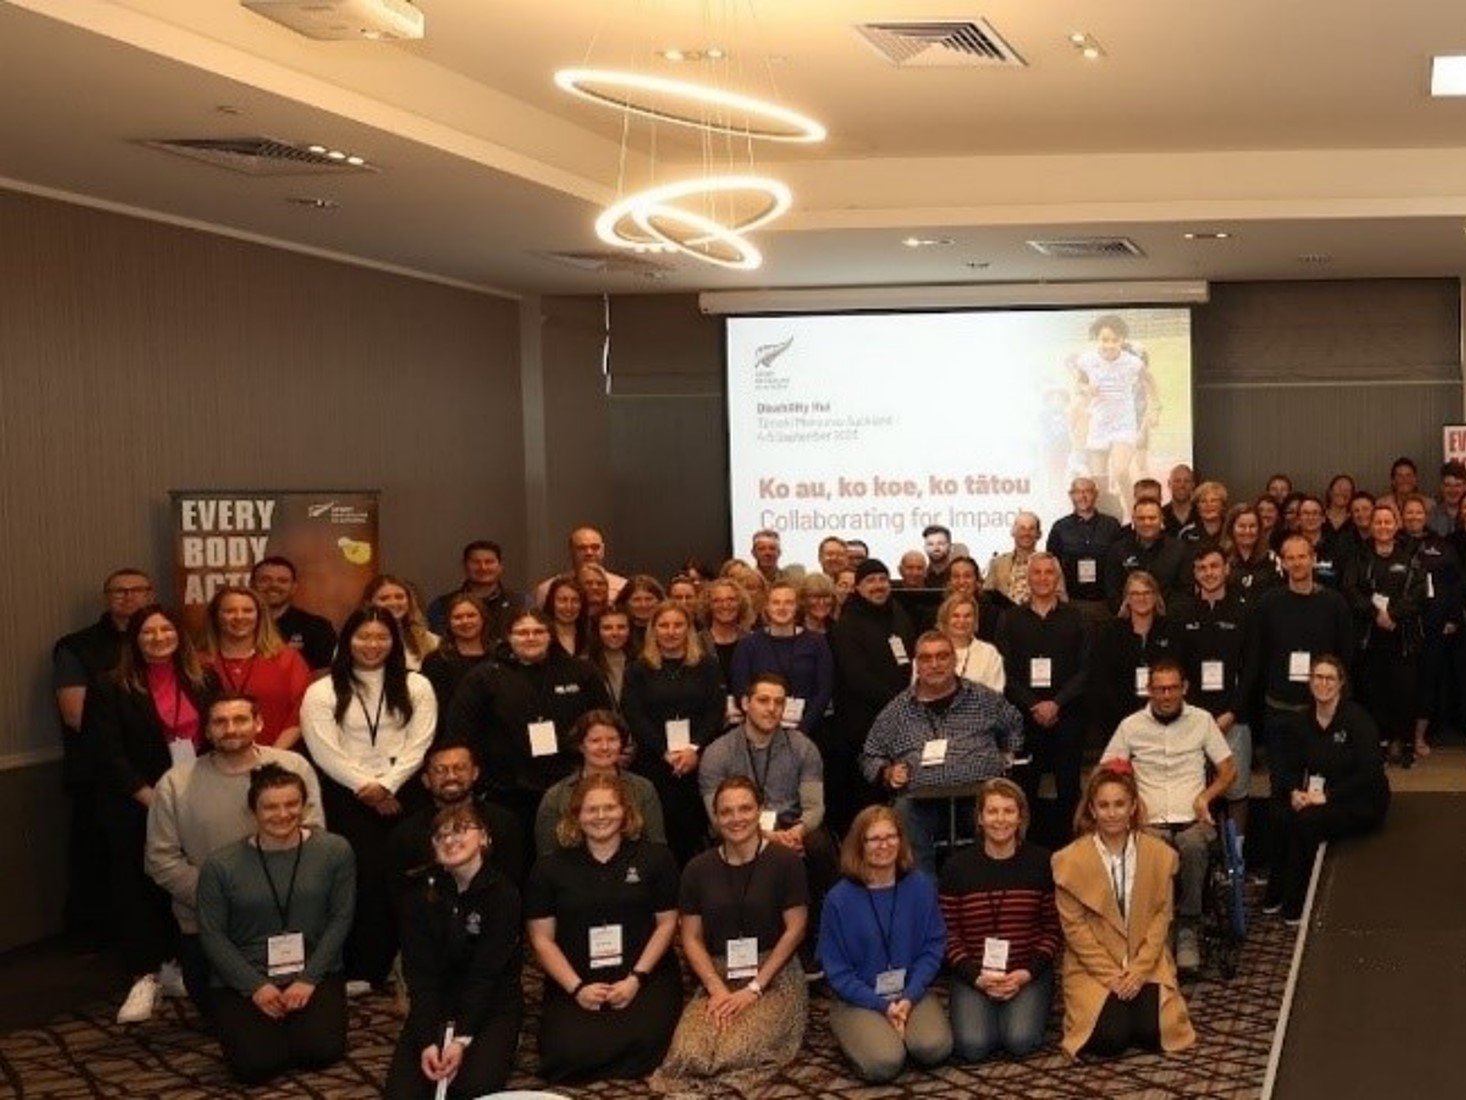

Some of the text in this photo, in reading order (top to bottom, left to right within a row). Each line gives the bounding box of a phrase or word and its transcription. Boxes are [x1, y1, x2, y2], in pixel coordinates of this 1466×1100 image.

[759, 477, 790, 499] Ko
[795, 480, 831, 501] au,
[838, 475, 867, 498] ko
[873, 474, 923, 499] koe,
[928, 474, 958, 497] ko
[181, 499, 276, 532] EVERY
[761, 507, 905, 533] Collaborating
[911, 506, 943, 528] for
[182, 535, 270, 569] BODY
